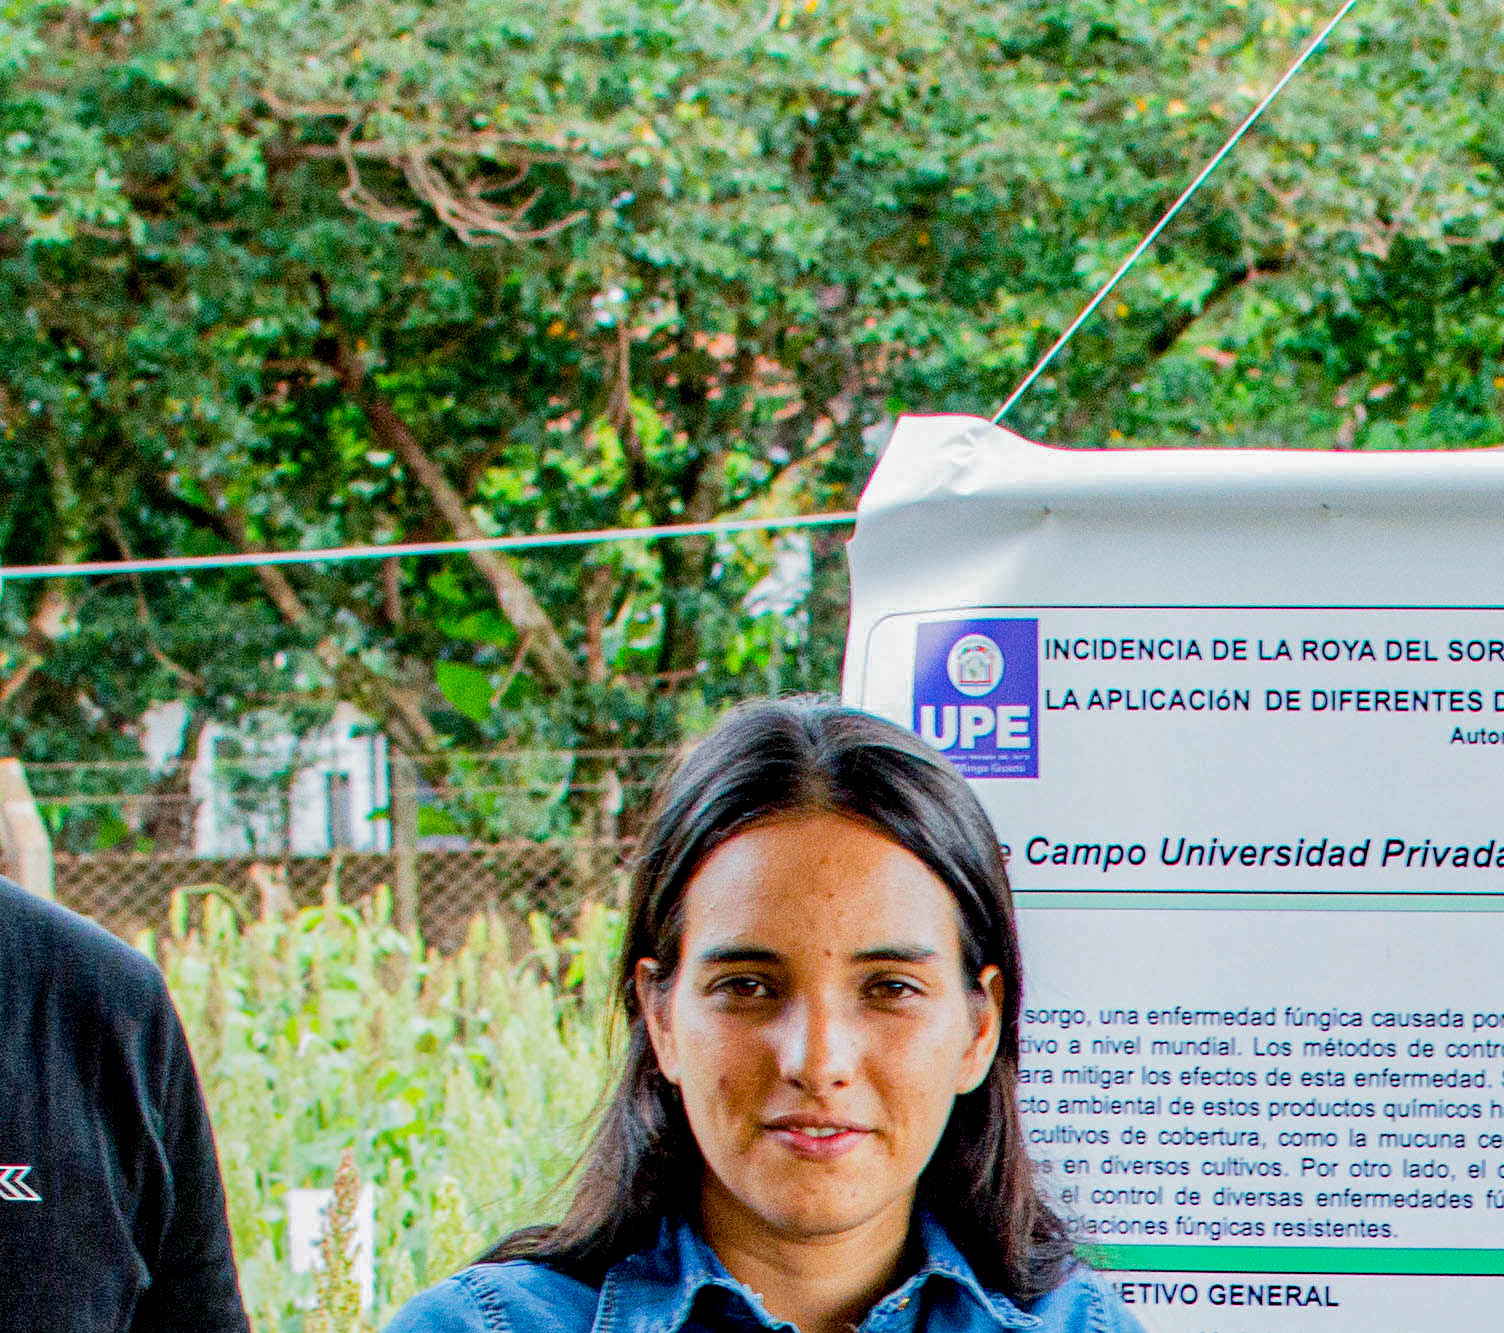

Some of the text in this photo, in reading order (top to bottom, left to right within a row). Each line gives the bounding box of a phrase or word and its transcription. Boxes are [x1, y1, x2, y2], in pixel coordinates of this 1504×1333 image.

[1045, 638, 1203, 661] INCIDENCIA
[1211, 638, 1248, 661] DE
[1257, 639, 1293, 661] LA
[1301, 640, 1377, 661] ROYA
[1384, 640, 1439, 662] DEL
[1045, 688, 1080, 711] LA
[1264, 689, 1301, 711] DE
[1311, 689, 1483, 712] DIFERENTES
[920, 705, 1031, 751] UPE
[1025, 836, 1146, 873] Campo
[1160, 837, 1372, 867] Universidad
[1024, 1009, 1091, 1029] sorgo,
[1099, 1010, 1139, 1025] una
[1146, 1006, 1277, 1026] enfermedad
[1284, 1007, 1363, 1032] fúngica
[1371, 1008, 1465, 1028] causada
[1056, 1095, 1161, 1115] ambiental
[1168, 1096, 1196, 1115] de
[1202, 1098, 1261, 1116] estos
[1268, 1098, 1377, 1121] productos
[1383, 1098, 1482, 1122] químicos
[1121, 1282, 1340, 1307] ETIVO GENERAL
